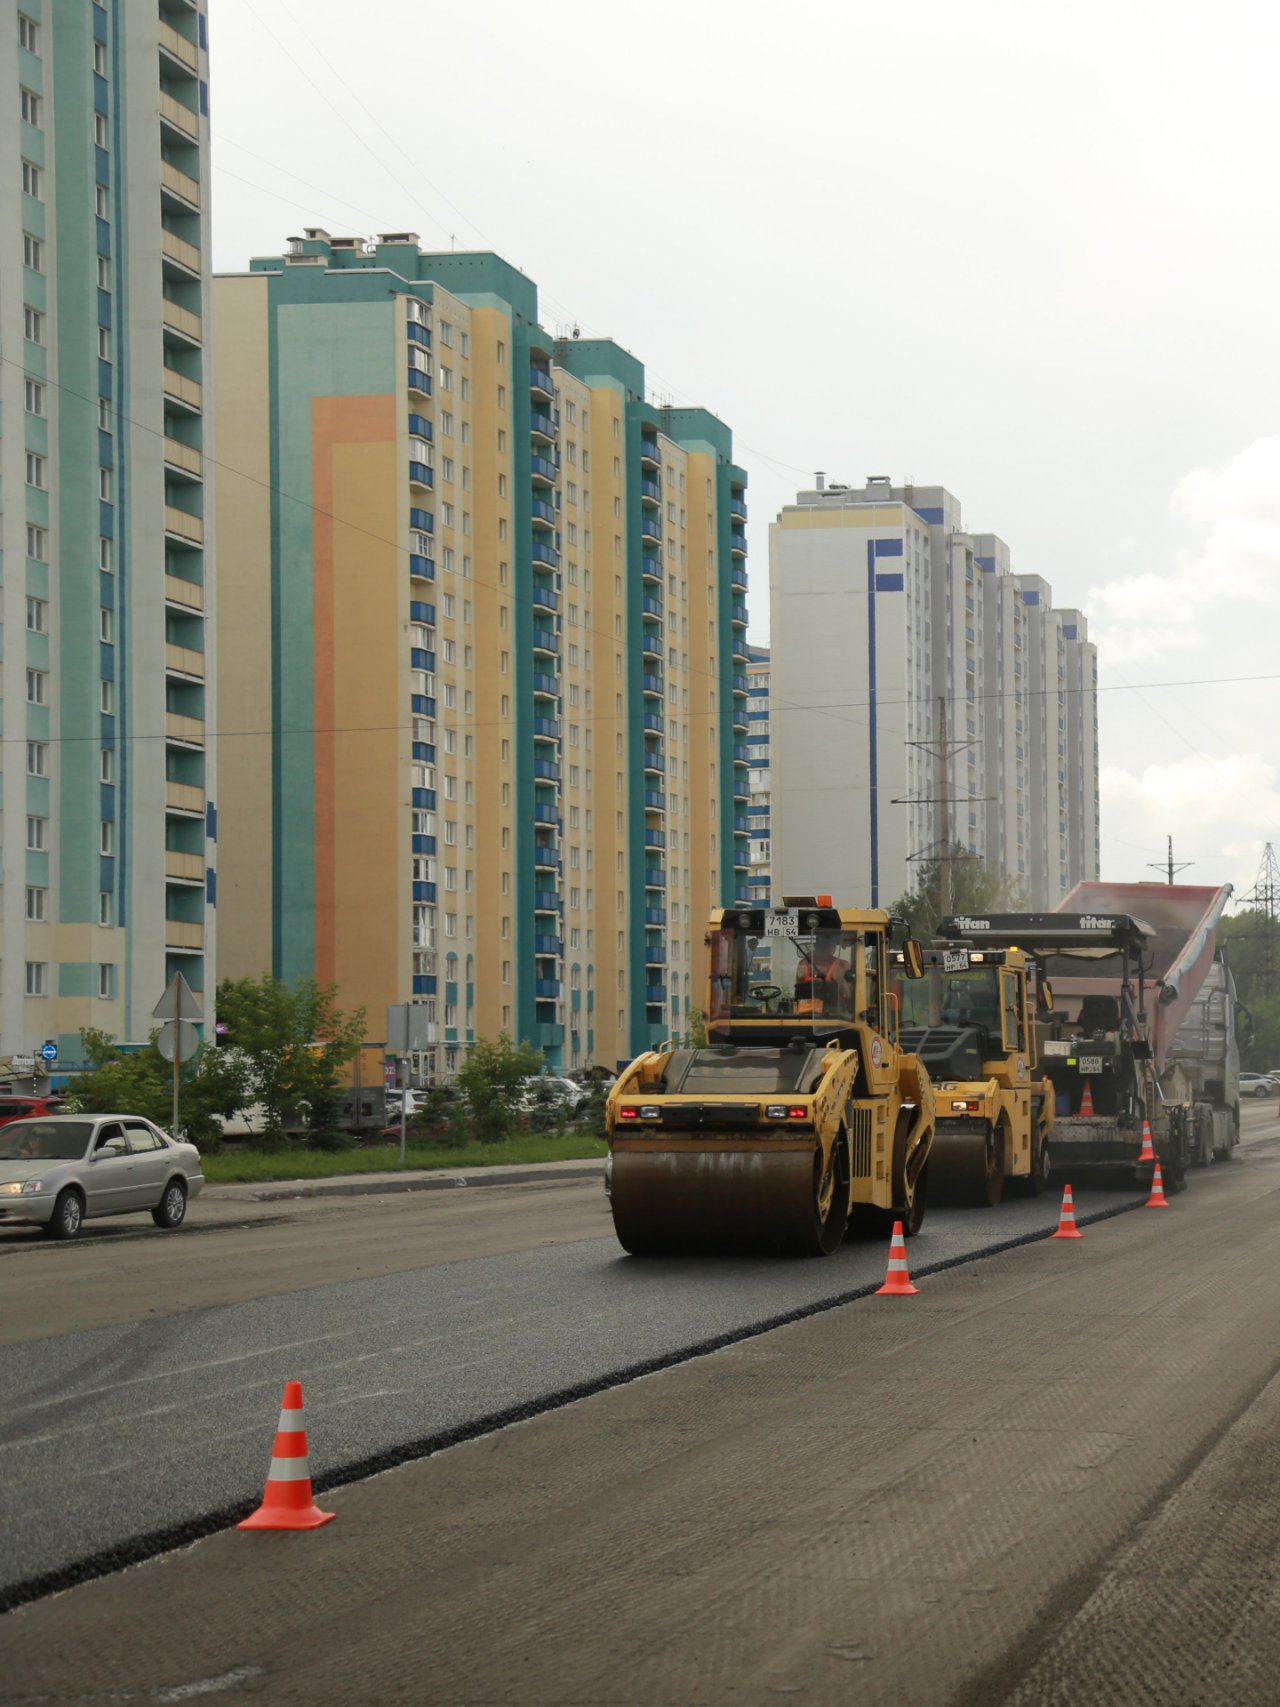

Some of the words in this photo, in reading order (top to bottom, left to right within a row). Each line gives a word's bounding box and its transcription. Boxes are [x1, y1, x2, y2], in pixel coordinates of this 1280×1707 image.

[769, 916, 795, 926] 7183
[954, 916, 990, 930] titan
[785, 928, 796, 936] 54
[946, 954, 965, 963] 0577
